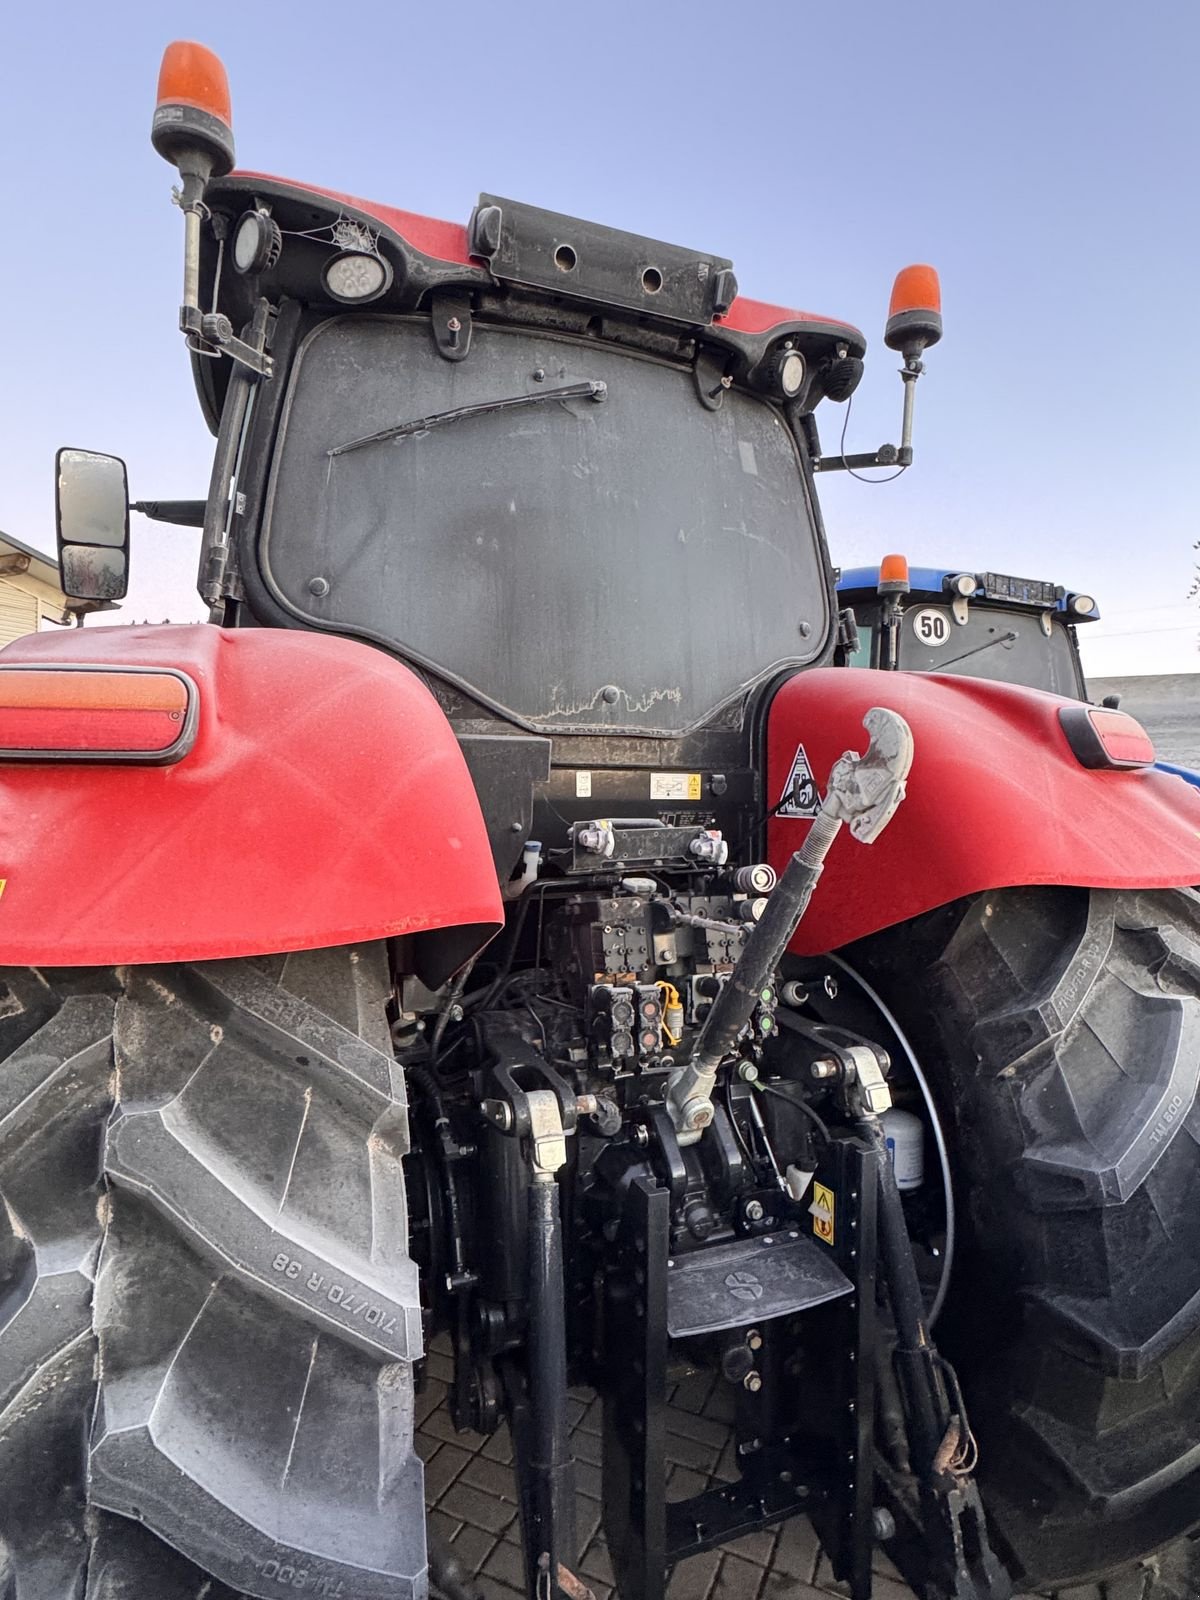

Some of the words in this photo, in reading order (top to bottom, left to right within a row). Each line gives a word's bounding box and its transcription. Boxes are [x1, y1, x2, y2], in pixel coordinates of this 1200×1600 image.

[921, 616, 944, 639] 50
[272, 1253, 302, 1279] 38
[306, 1272, 324, 1292] R
[326, 1285, 397, 1335] 710/70
[261, 1560, 309, 1589] 800
